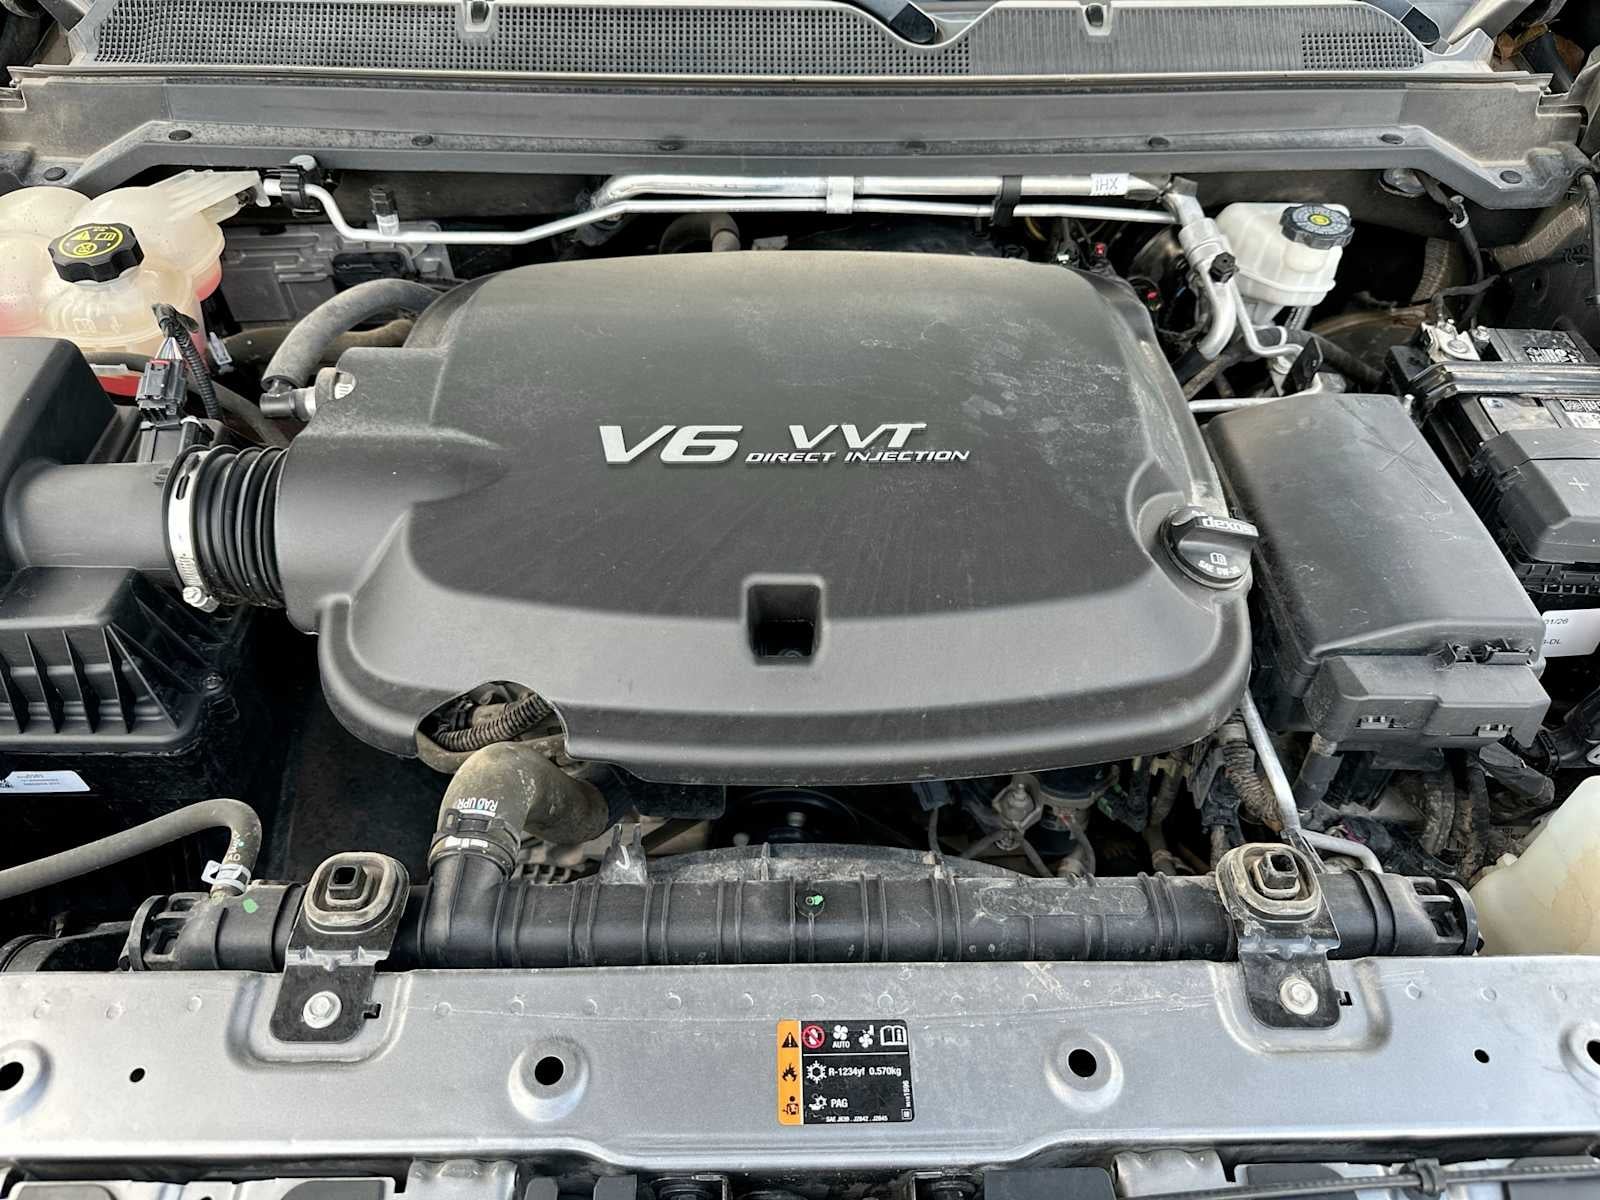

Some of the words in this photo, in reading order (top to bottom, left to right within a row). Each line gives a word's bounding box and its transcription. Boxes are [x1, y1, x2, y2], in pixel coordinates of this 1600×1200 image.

[599, 424, 744, 465] V6
[788, 423, 928, 449] VVT
[744, 451, 837, 464] DIRECT
[843, 450, 971, 463] INJECTION
[832, 1040, 850, 1049] AUTO
[828, 1066, 865, 1077] R-1234yf
[868, 1066, 902, 1077] 0.570kg
[830, 1098, 848, 1108] PAG
